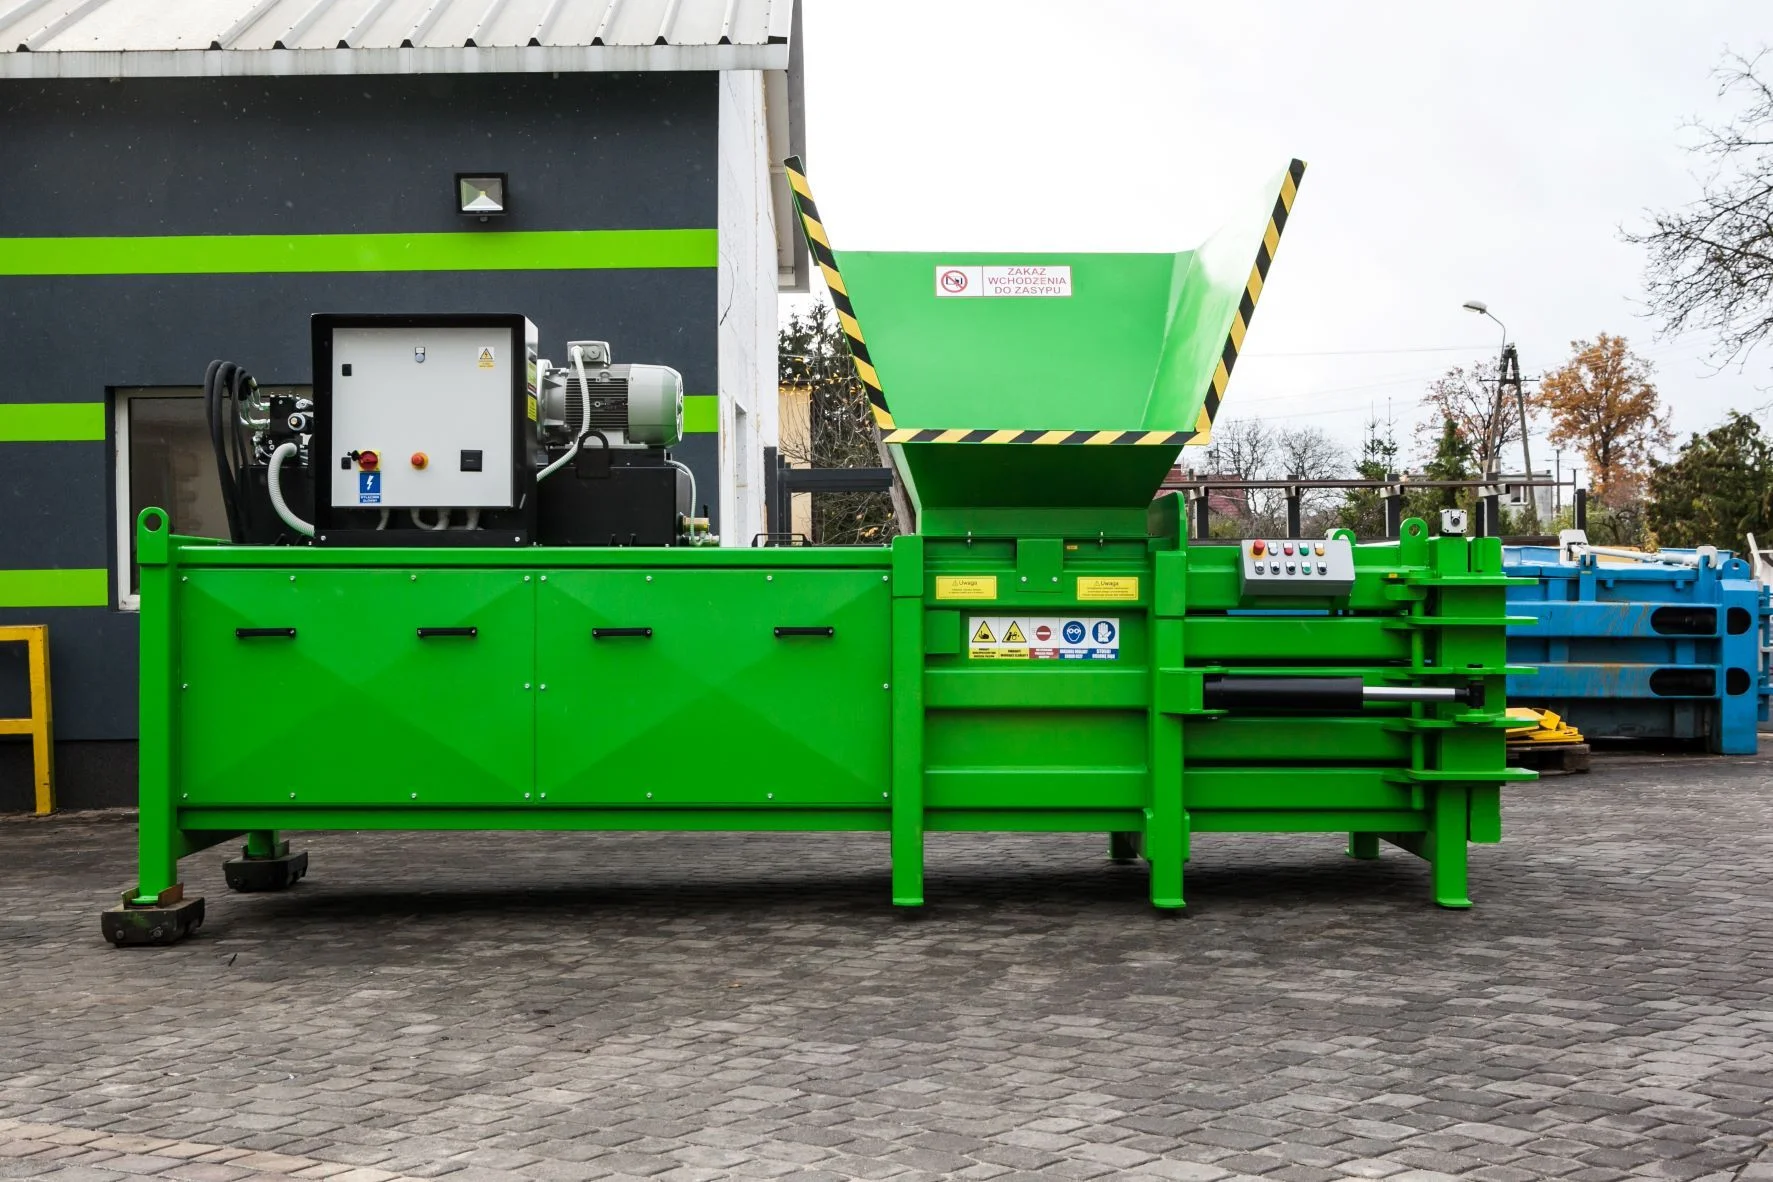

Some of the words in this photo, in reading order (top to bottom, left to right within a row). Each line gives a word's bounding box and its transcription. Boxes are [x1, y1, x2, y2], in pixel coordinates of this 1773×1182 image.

[1007, 267, 1047, 276] ZAKAZ
[988, 276, 1067, 285] WCHODZENIA
[994, 286, 1012, 294] DO
[1014, 286, 1061, 294] ZASYPU
